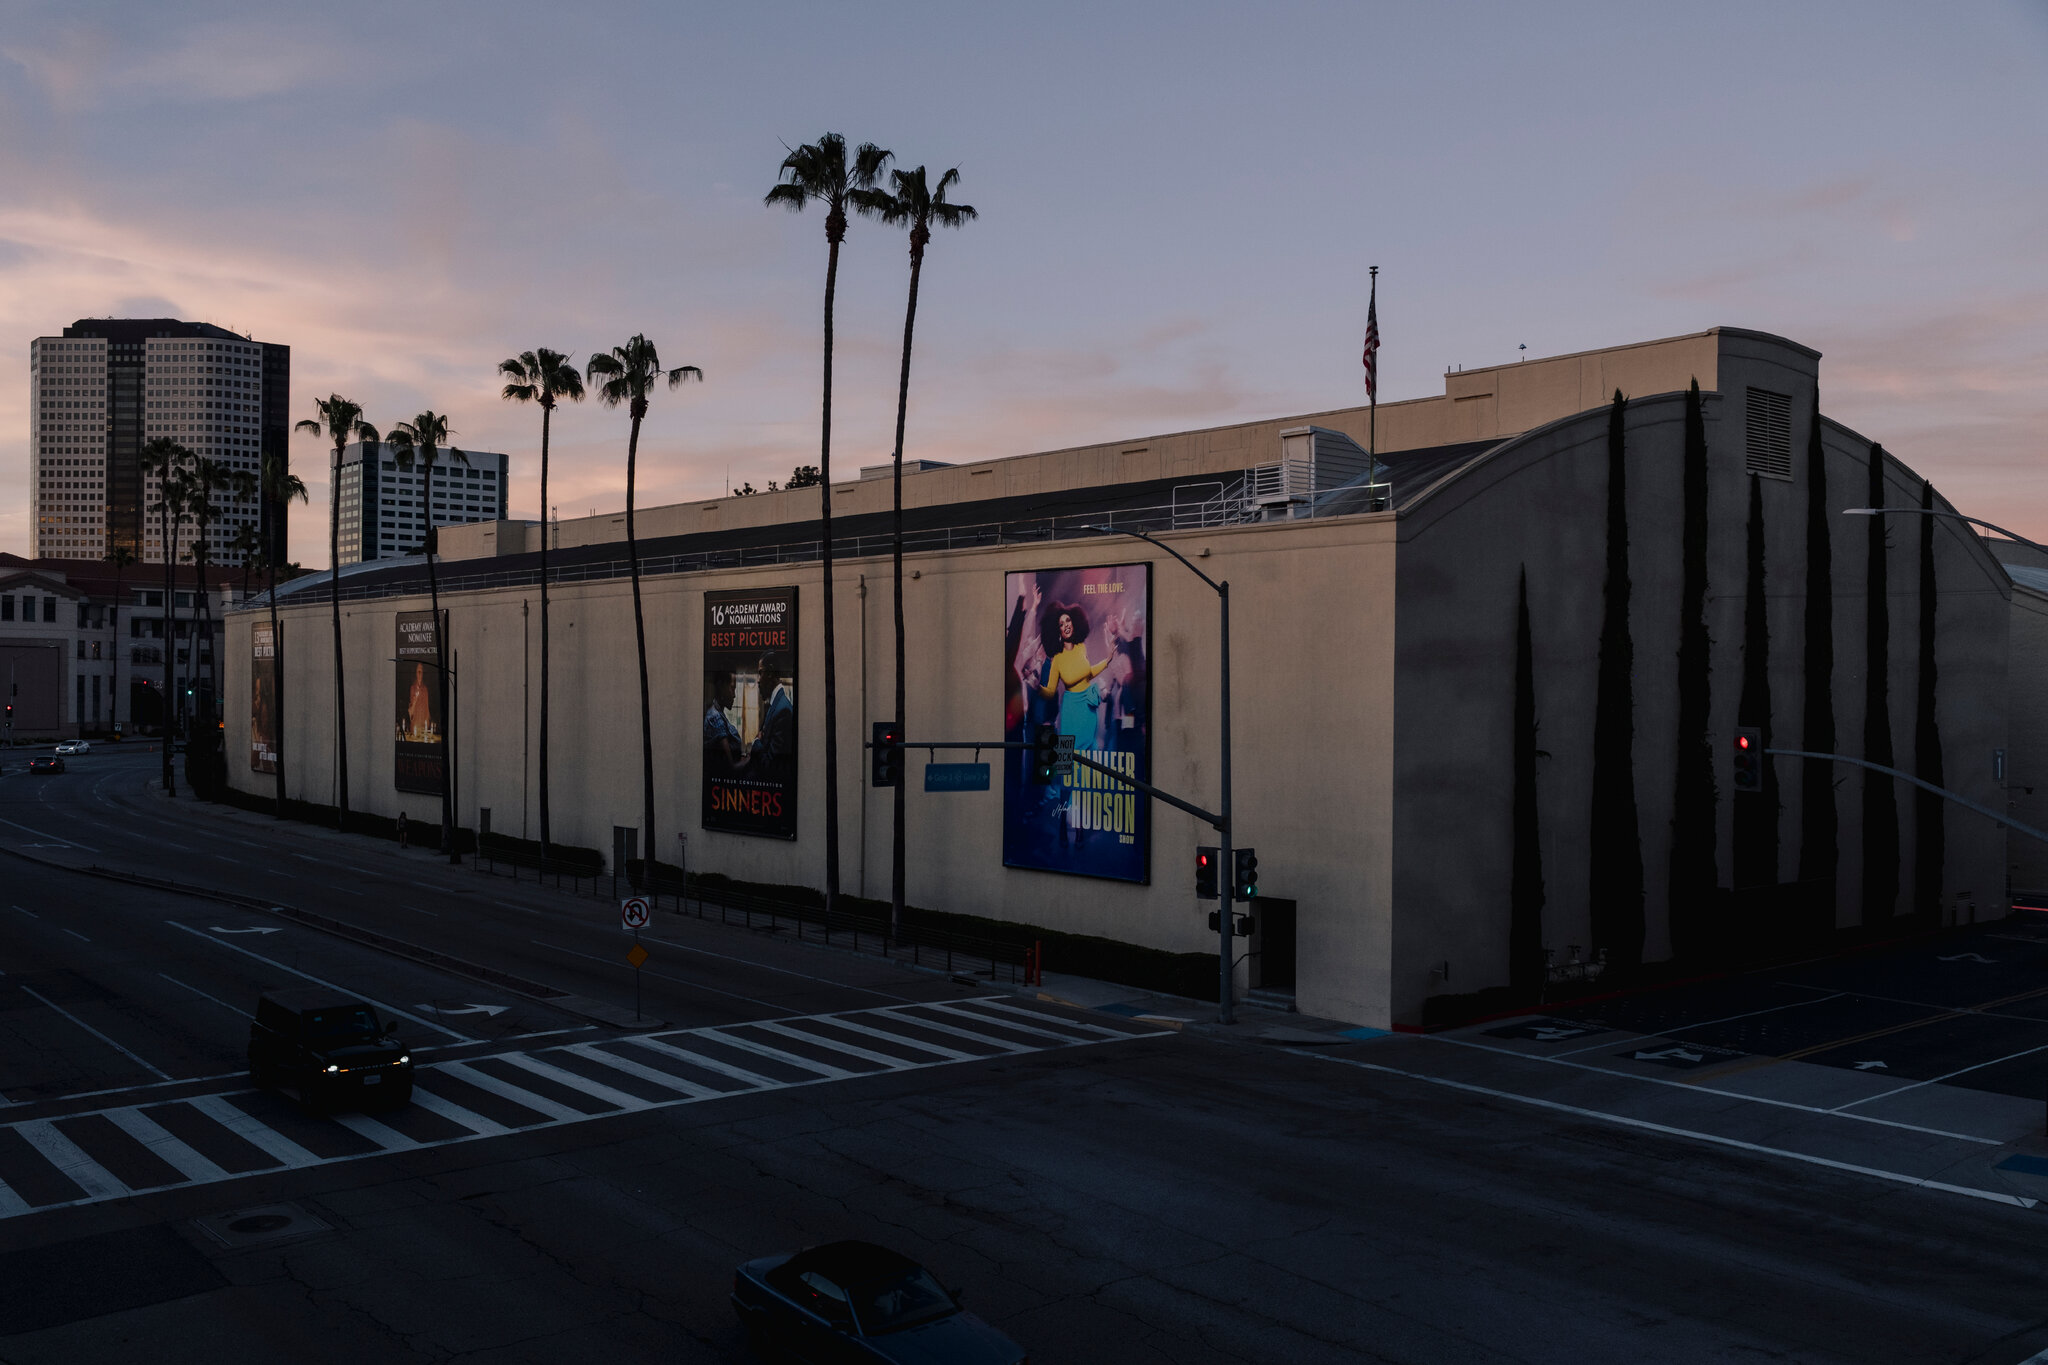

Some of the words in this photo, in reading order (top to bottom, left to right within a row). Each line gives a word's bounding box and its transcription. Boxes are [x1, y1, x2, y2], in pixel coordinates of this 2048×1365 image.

[1084, 584, 1096, 594] FEEL
[1097, 584, 1108, 594] THE
[1109, 582, 1125, 593] LOVE.
[712, 605, 724, 625] 16
[725, 604, 759, 615] ACADEMY
[760, 603, 787, 613] AWARD
[730, 613, 781, 625] NOMINATIONS
[399, 622, 421, 633] ACADEMY
[408, 632, 432, 643] NOMINEE
[712, 632, 735, 647] BEST
[740, 631, 786, 647] PICTURE
[1060, 739, 1072, 749] NOT
[711, 785, 783, 818] SINNERS
[1071, 790, 1136, 834] HUDSON
